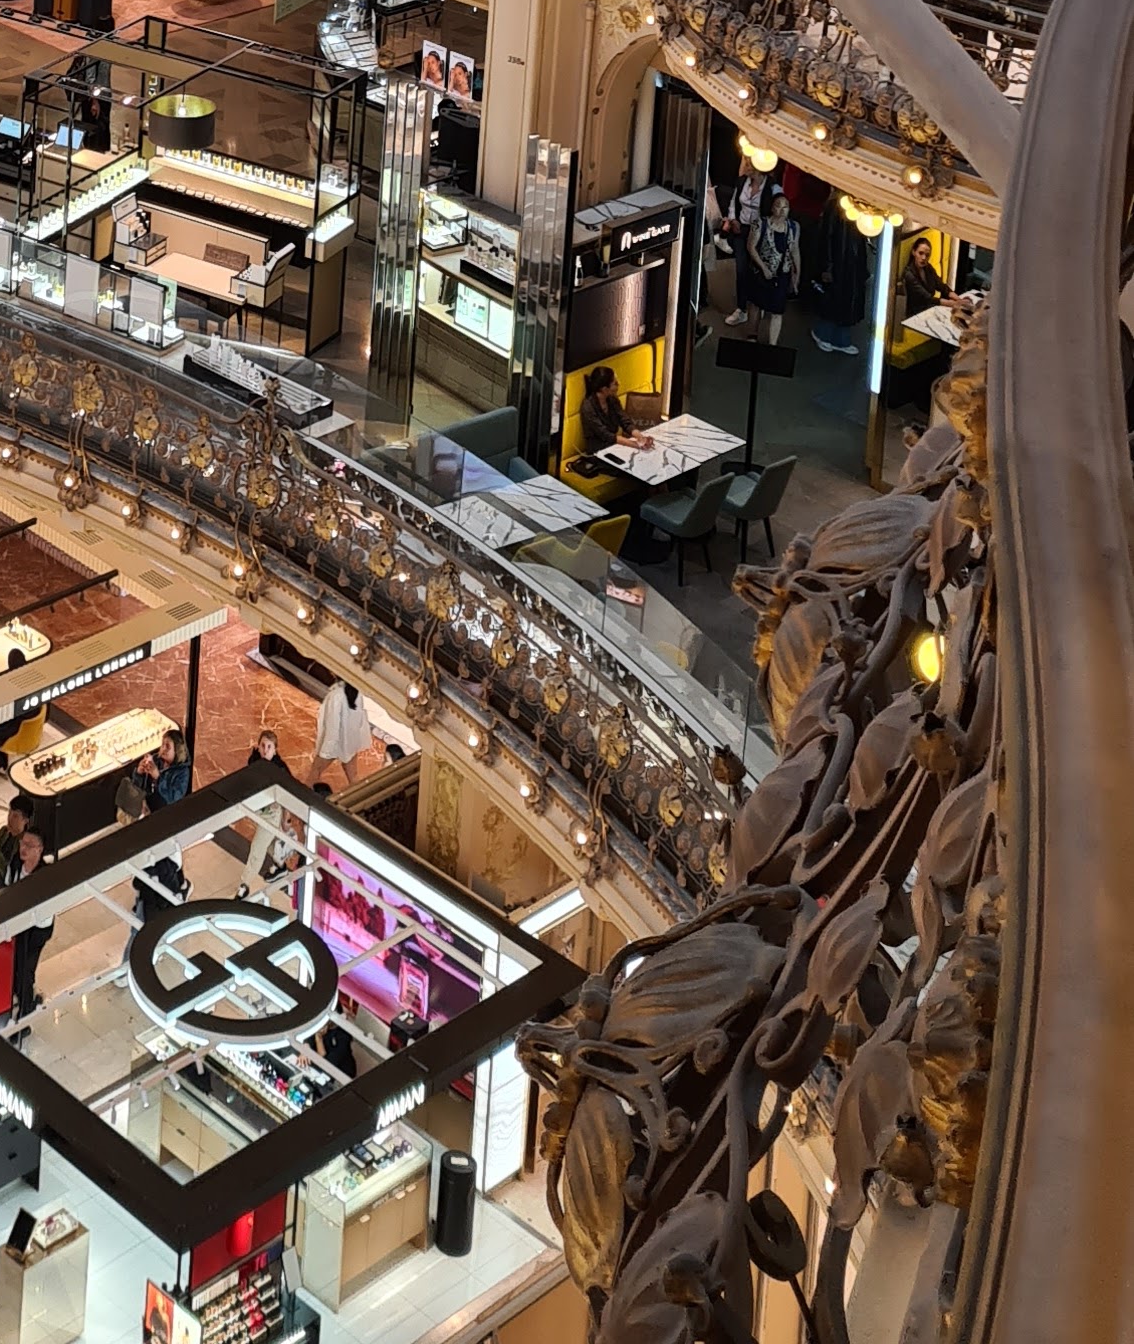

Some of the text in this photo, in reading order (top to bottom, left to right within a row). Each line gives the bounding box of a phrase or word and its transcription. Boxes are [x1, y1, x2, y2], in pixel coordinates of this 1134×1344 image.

[23, 649, 143, 710] JO MALONE LONDON
[376, 1082, 425, 1130] ARMANI
